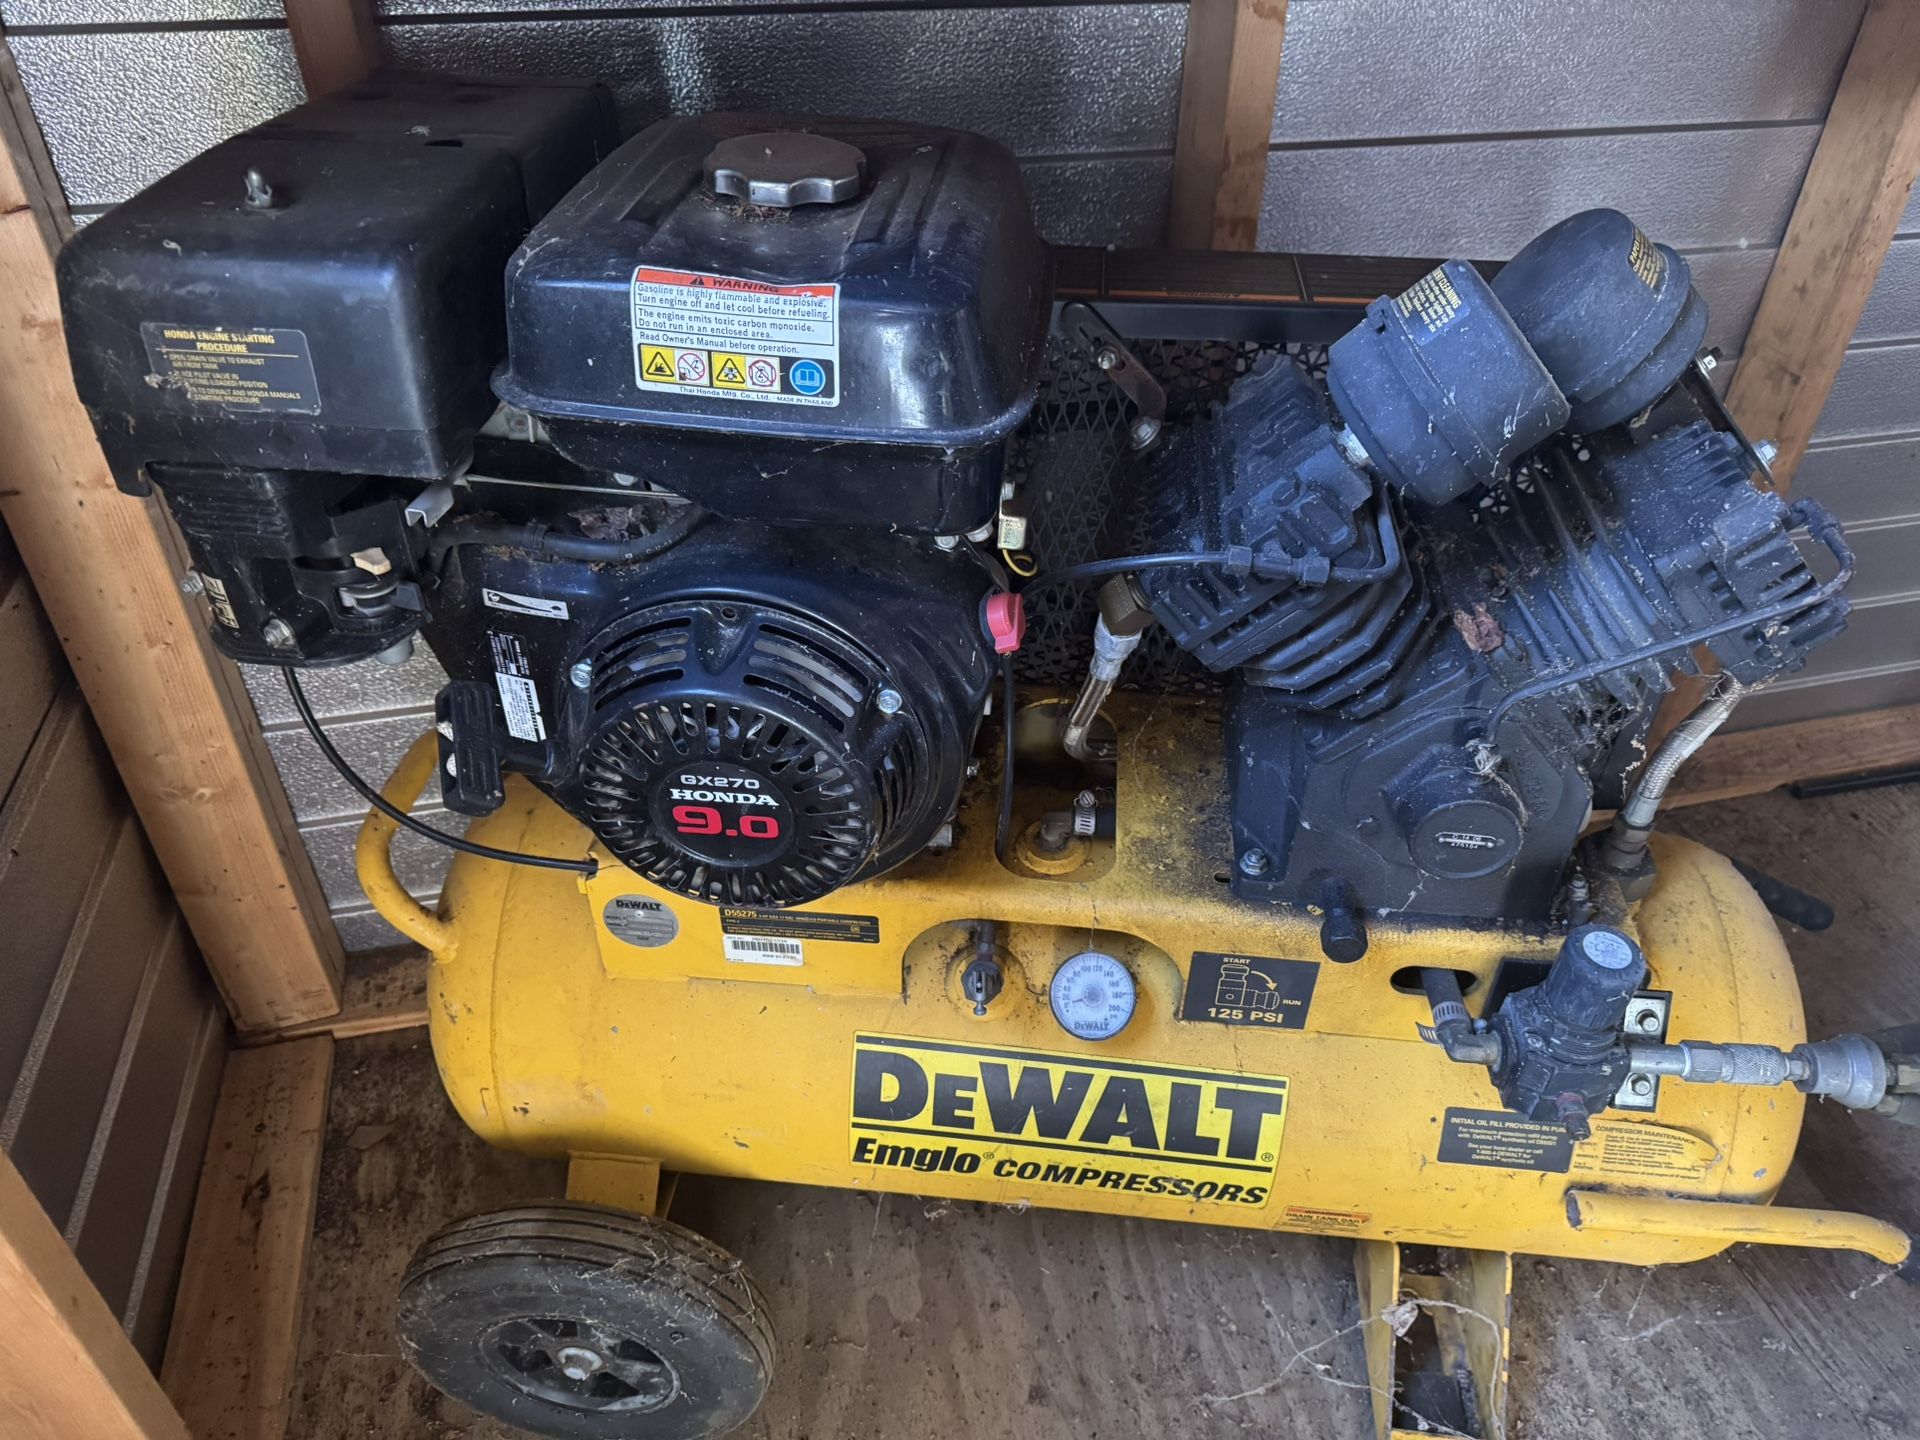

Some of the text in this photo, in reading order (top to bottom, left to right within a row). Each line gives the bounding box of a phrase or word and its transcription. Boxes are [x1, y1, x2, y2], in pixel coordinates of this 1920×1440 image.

[713, 279, 779, 293] WARNING
[637, 283, 826, 308] Gasoline is highly flammable and explosive.
[1439, 278, 1462, 309] CLEANING
[638, 293, 830, 320] Turn engine off and let cool before refueling.
[638, 308, 814, 332] The engine emits toxic carbon monoxide.
[639, 318, 650, 327] Do
[653, 321, 666, 329] not
[686, 323, 694, 331] in
[710, 326, 748, 337] enclosed
[751, 330, 773, 339] area.
[164, 330, 275, 343] HONDA ENGINE STARTING
[640, 331, 799, 354] Read Owner's Manual before operation.
[196, 342, 248, 353] PROCEDURE
[269, 392, 301, 400] MANUALS
[696, 388, 720, 396] Honda
[803, 398, 834, 406] THAILAND
[680, 774, 760, 790] GX270
[669, 788, 780, 806] HONDA
[672, 805, 780, 839] 9.0
[615, 899, 662, 912] DEWALT
[724, 909, 757, 918] D55275
[1223, 957, 1251, 965] START
[1109, 980, 1119, 988] 160
[1112, 991, 1123, 999] 180
[1108, 1004, 1120, 1012] 200
[1208, 1007, 1284, 1024] 125 PSI
[1073, 1021, 1110, 1031] DEWALT
[1450, 1117, 1475, 1125] INITIAL
[1476, 1119, 1488, 1127] OIL
[1489, 1120, 1503, 1128] FILL
[1505, 1121, 1541, 1131] PROVIDED
[1541, 1124, 1550, 1132] IN
[1498, 1130, 1527, 1138] protection
[1502, 1136, 1527, 1144] synthetic
[1596, 1125, 1643, 1136] COMPRESSOR
[1644, 1129, 1697, 1145] MAINTENANCE
[1501, 1156, 1526, 1164] synthetic
[993, 1159, 1268, 1206] COMPRESSORS
